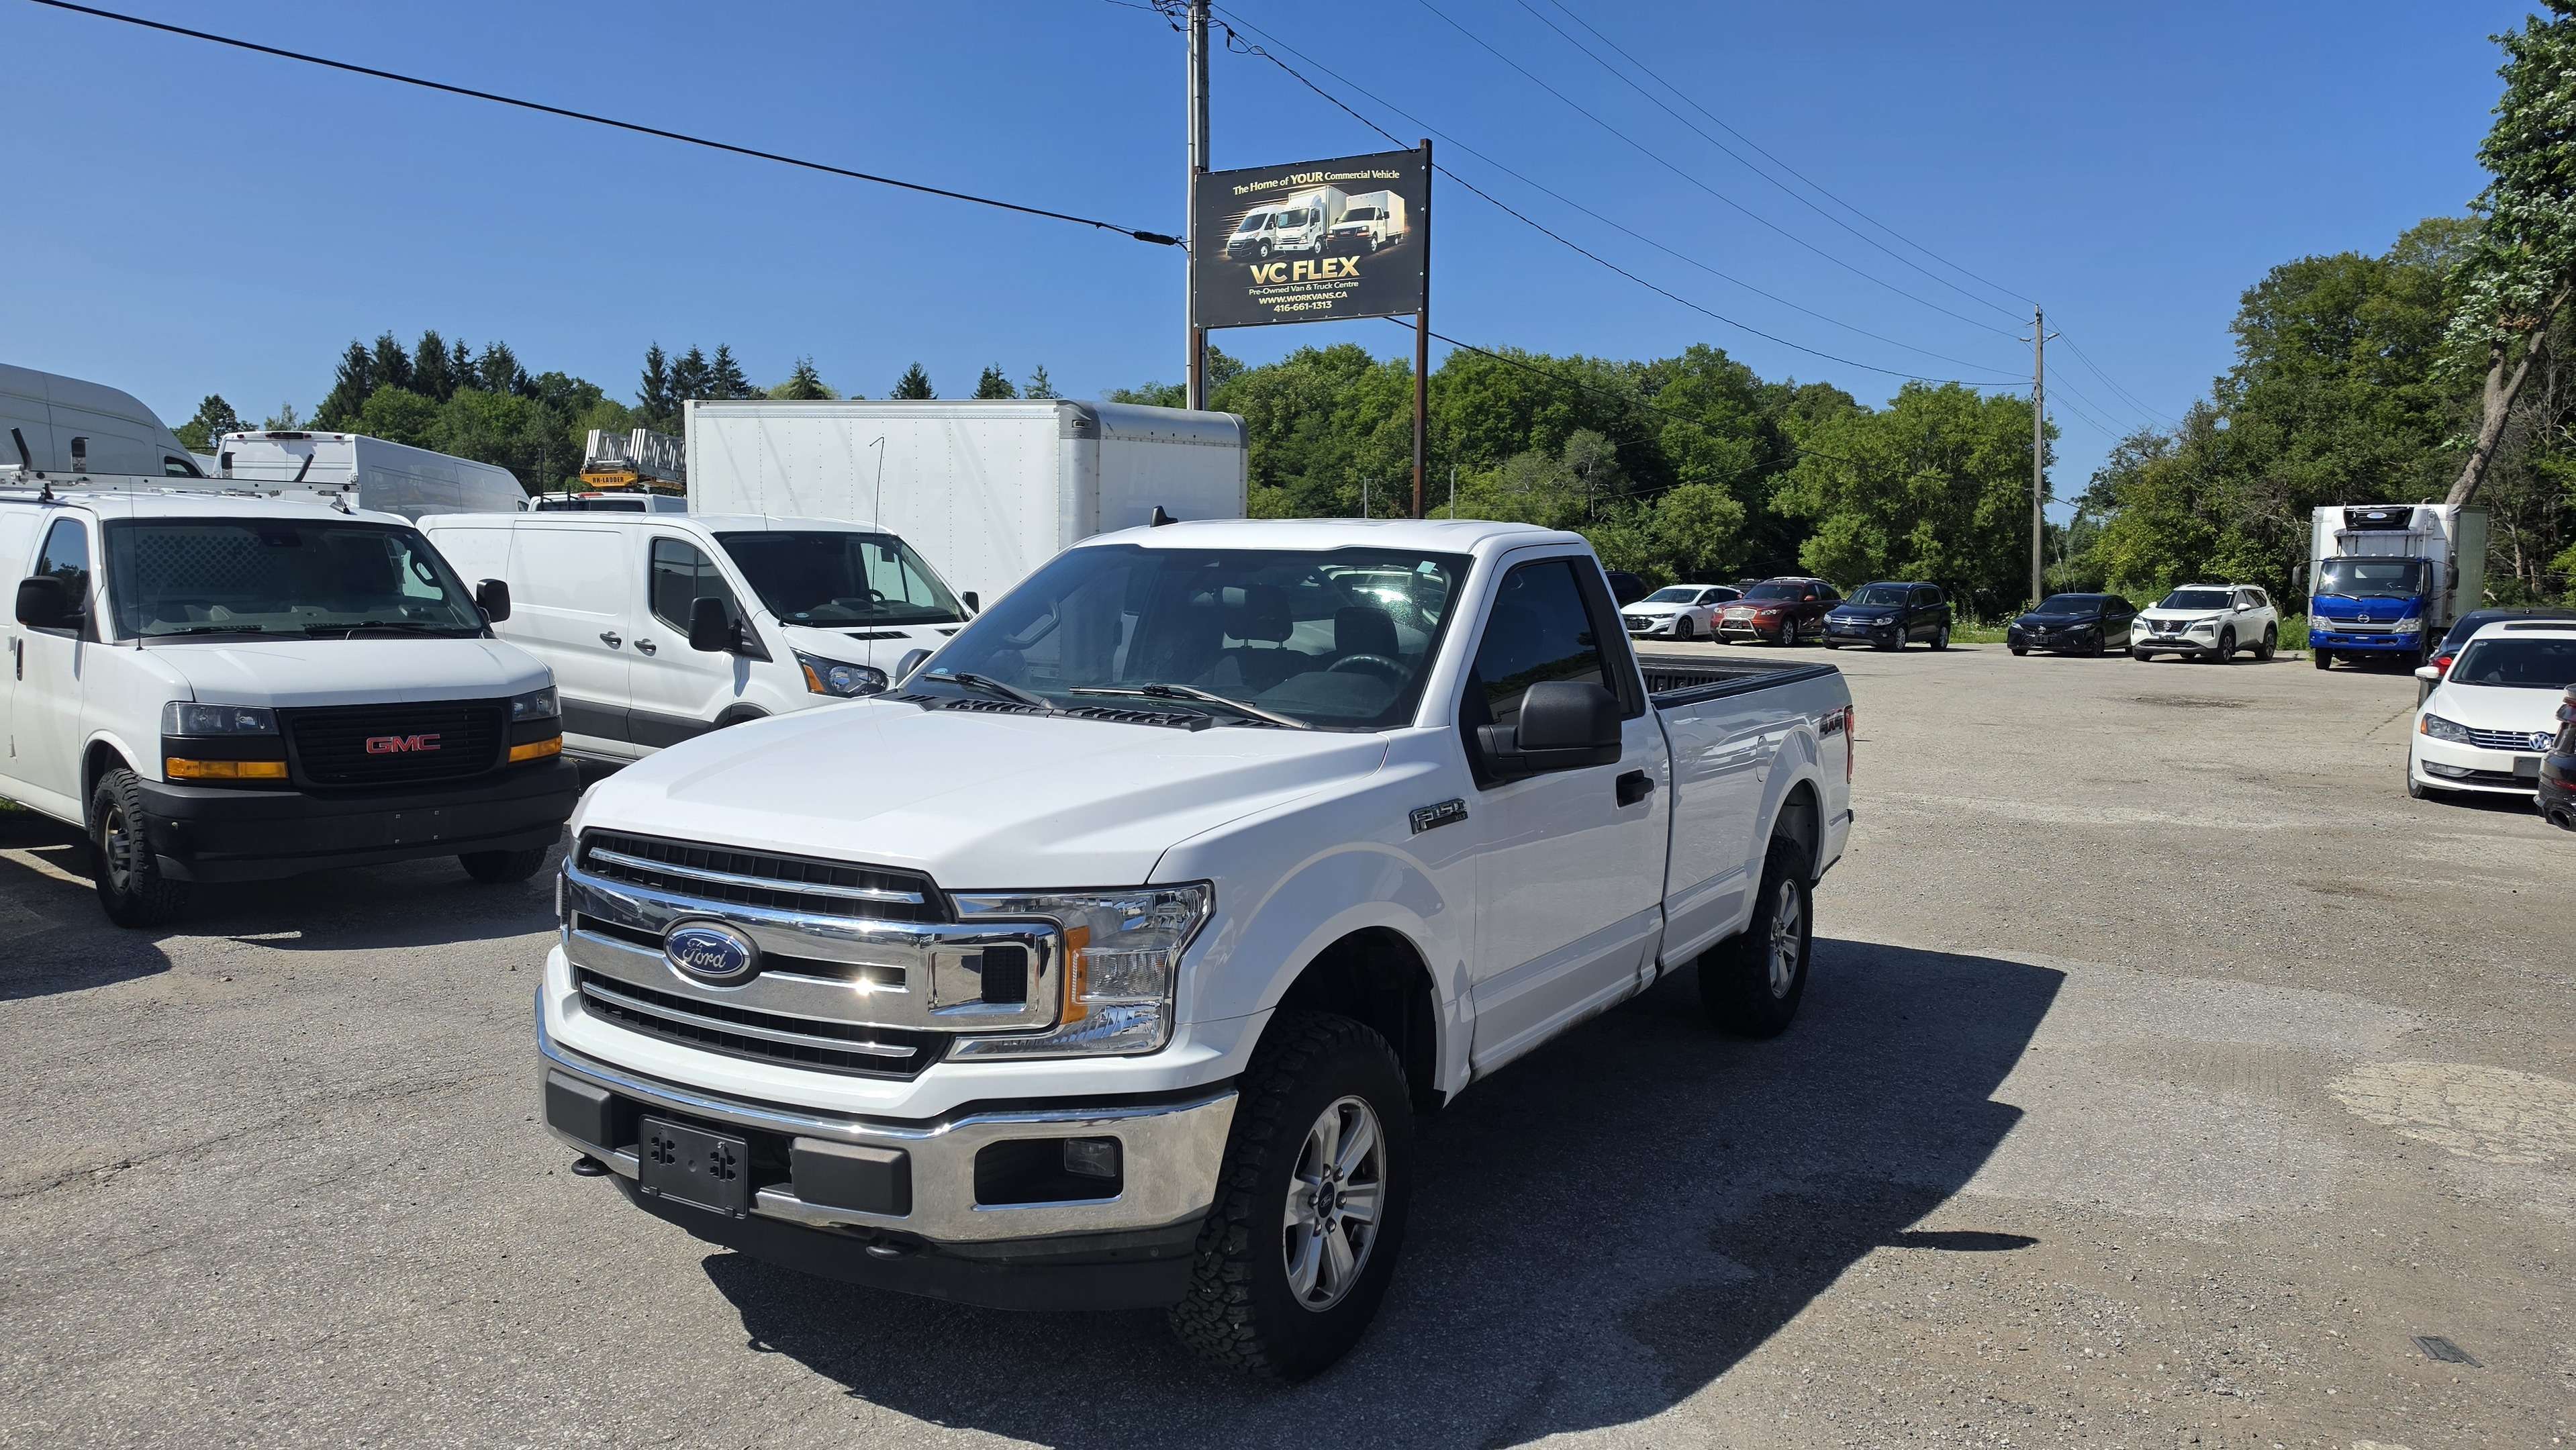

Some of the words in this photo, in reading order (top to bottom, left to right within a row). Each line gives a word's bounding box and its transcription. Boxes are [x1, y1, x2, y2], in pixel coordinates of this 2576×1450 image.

[1233, 185, 1249, 195] The
[1249, 180, 1278, 191] Home
[1280, 177, 1290, 185] of
[1290, 171, 1323, 184] YOUR
[1325, 171, 1370, 181] Commercial
[1371, 170, 1400, 179] Vehicle
[1249, 262, 1288, 284] VC
[1292, 255, 1361, 281] FLEX
[1249, 285, 1289, 295] Pre-Owned
[1313, 282, 1333, 290] Truck
[1334, 281, 1359, 289] Centre
[1259, 291, 1347, 305] WWW.WORKVANS.CA
[1274, 300, 1332, 312] 416-661-1313
[366, 734, 440, 754] GMC
[682, 938, 728, 969] Ford
